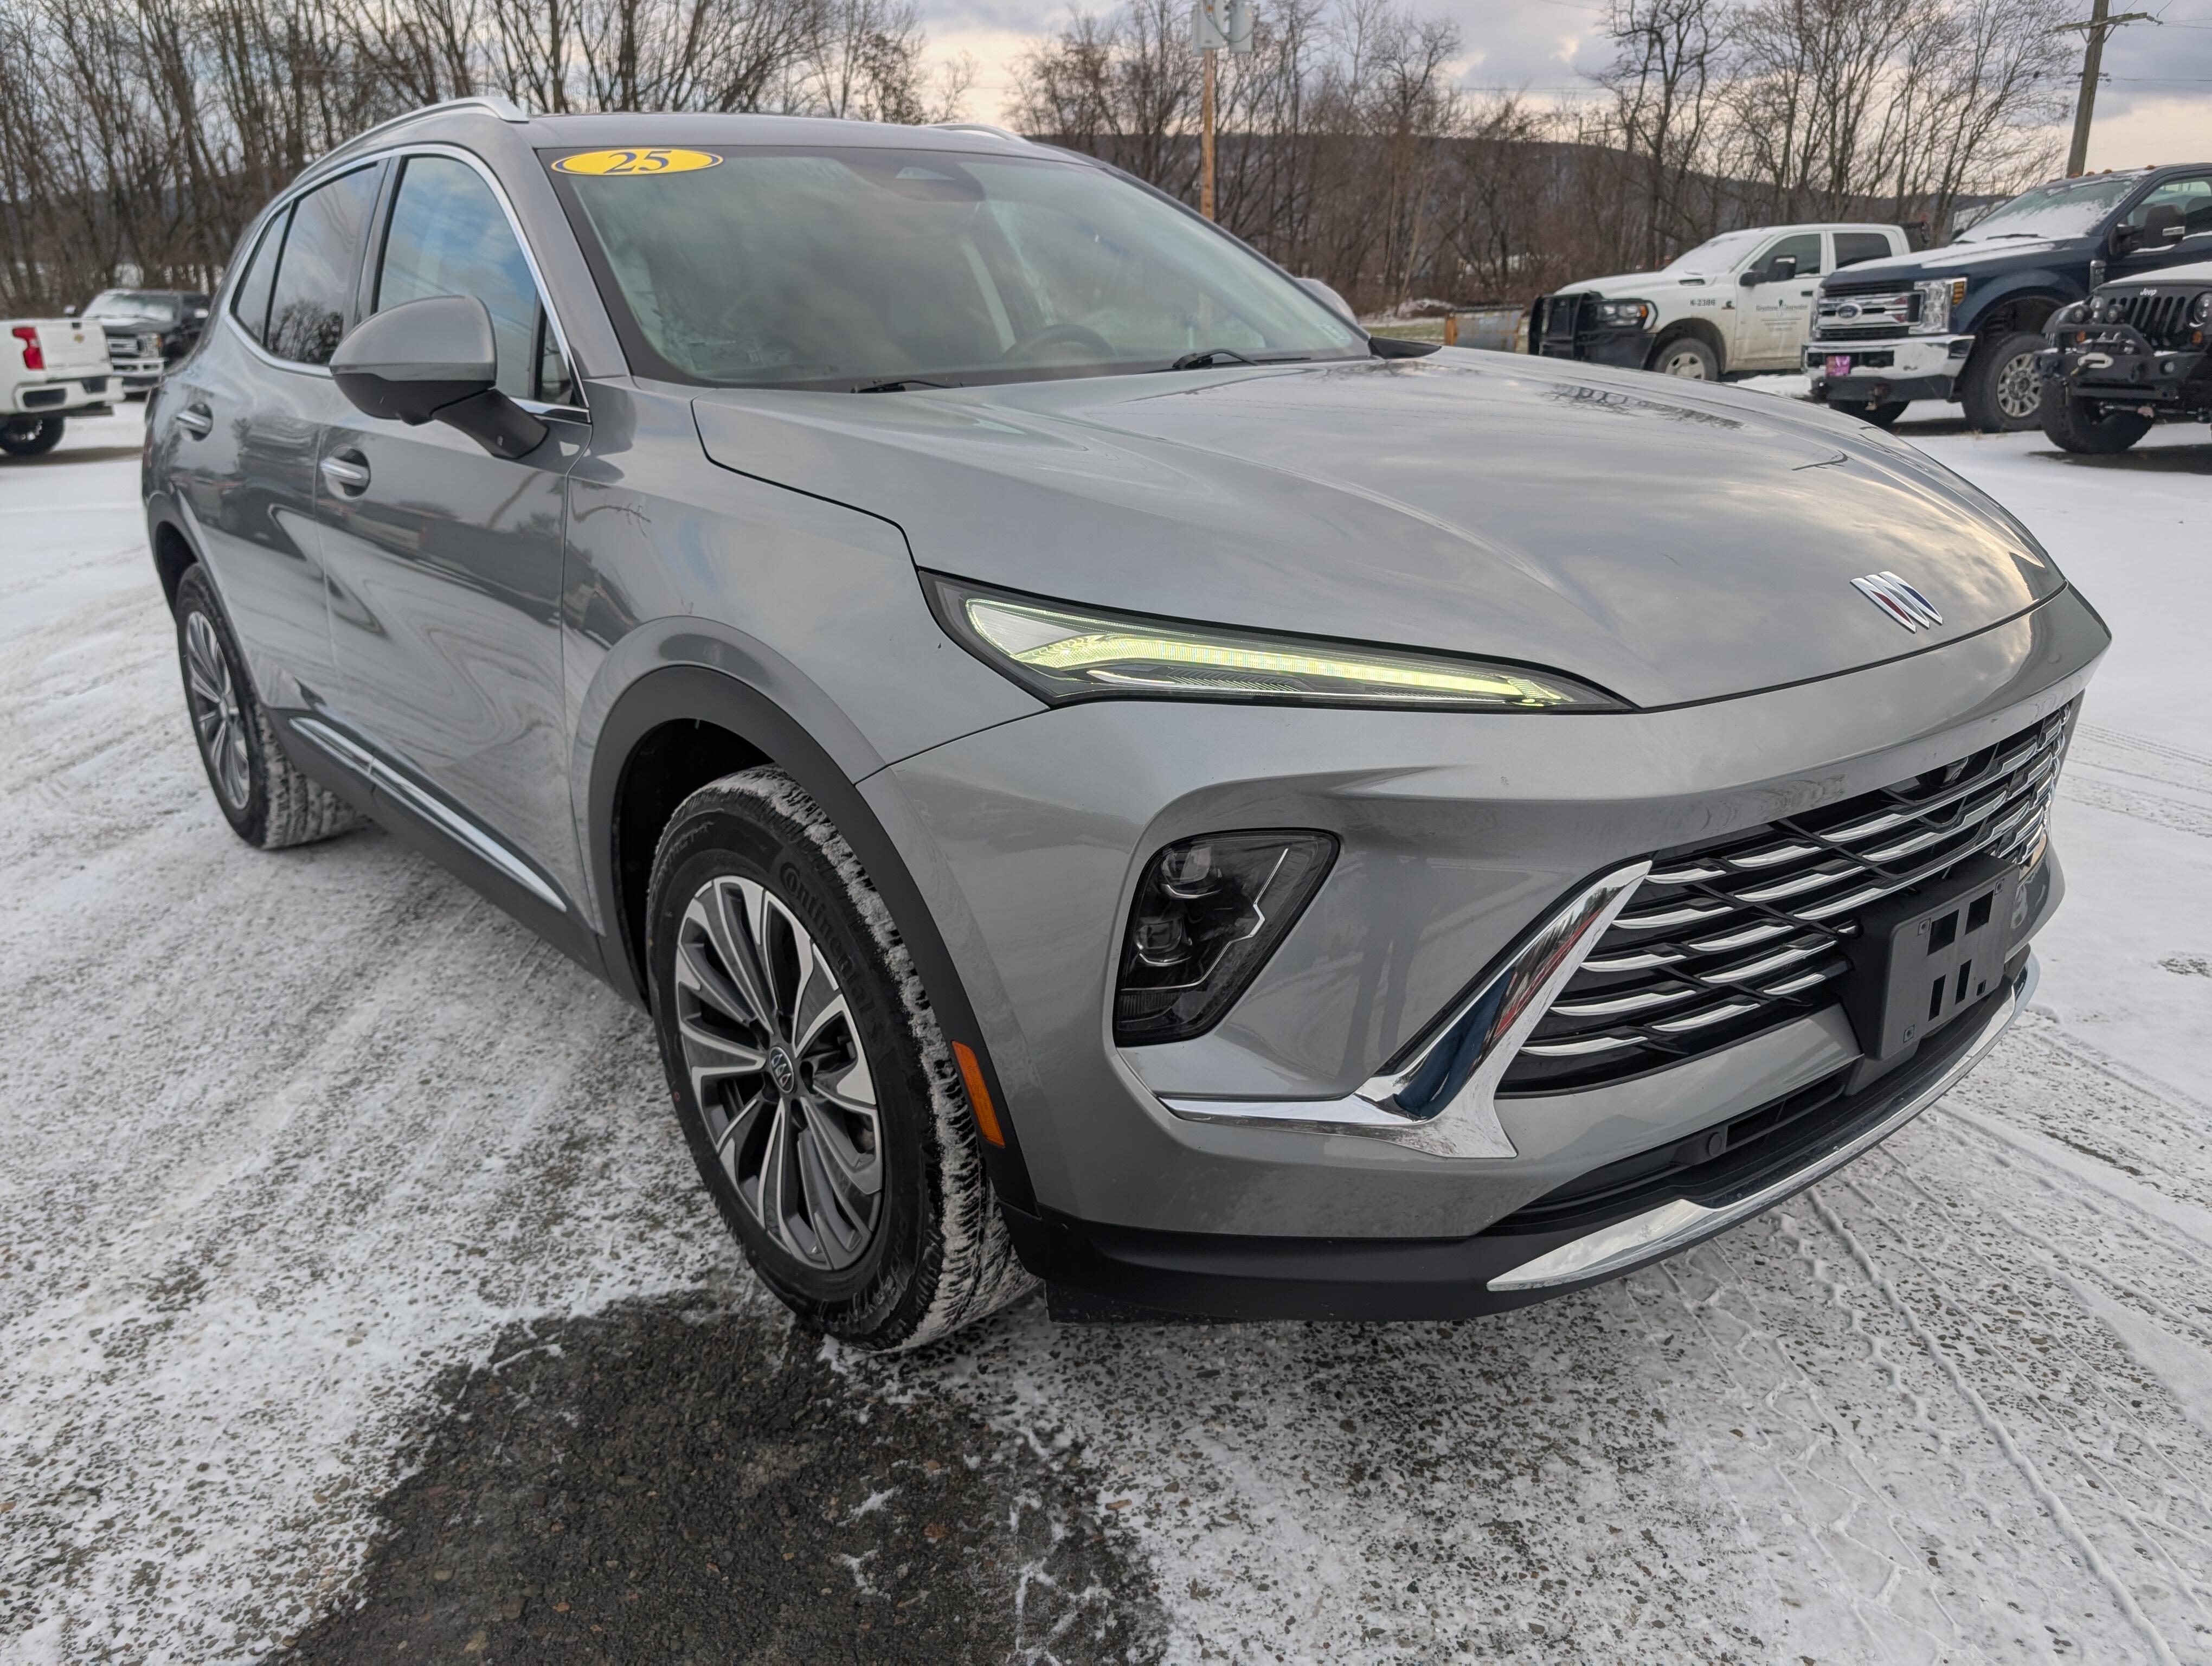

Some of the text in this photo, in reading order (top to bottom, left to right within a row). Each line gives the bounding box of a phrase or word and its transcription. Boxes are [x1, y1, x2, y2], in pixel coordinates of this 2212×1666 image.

[603, 150, 673, 174] 25
[2139, 287, 2157, 297] Jeep
[780, 862, 875, 1015] Continental
